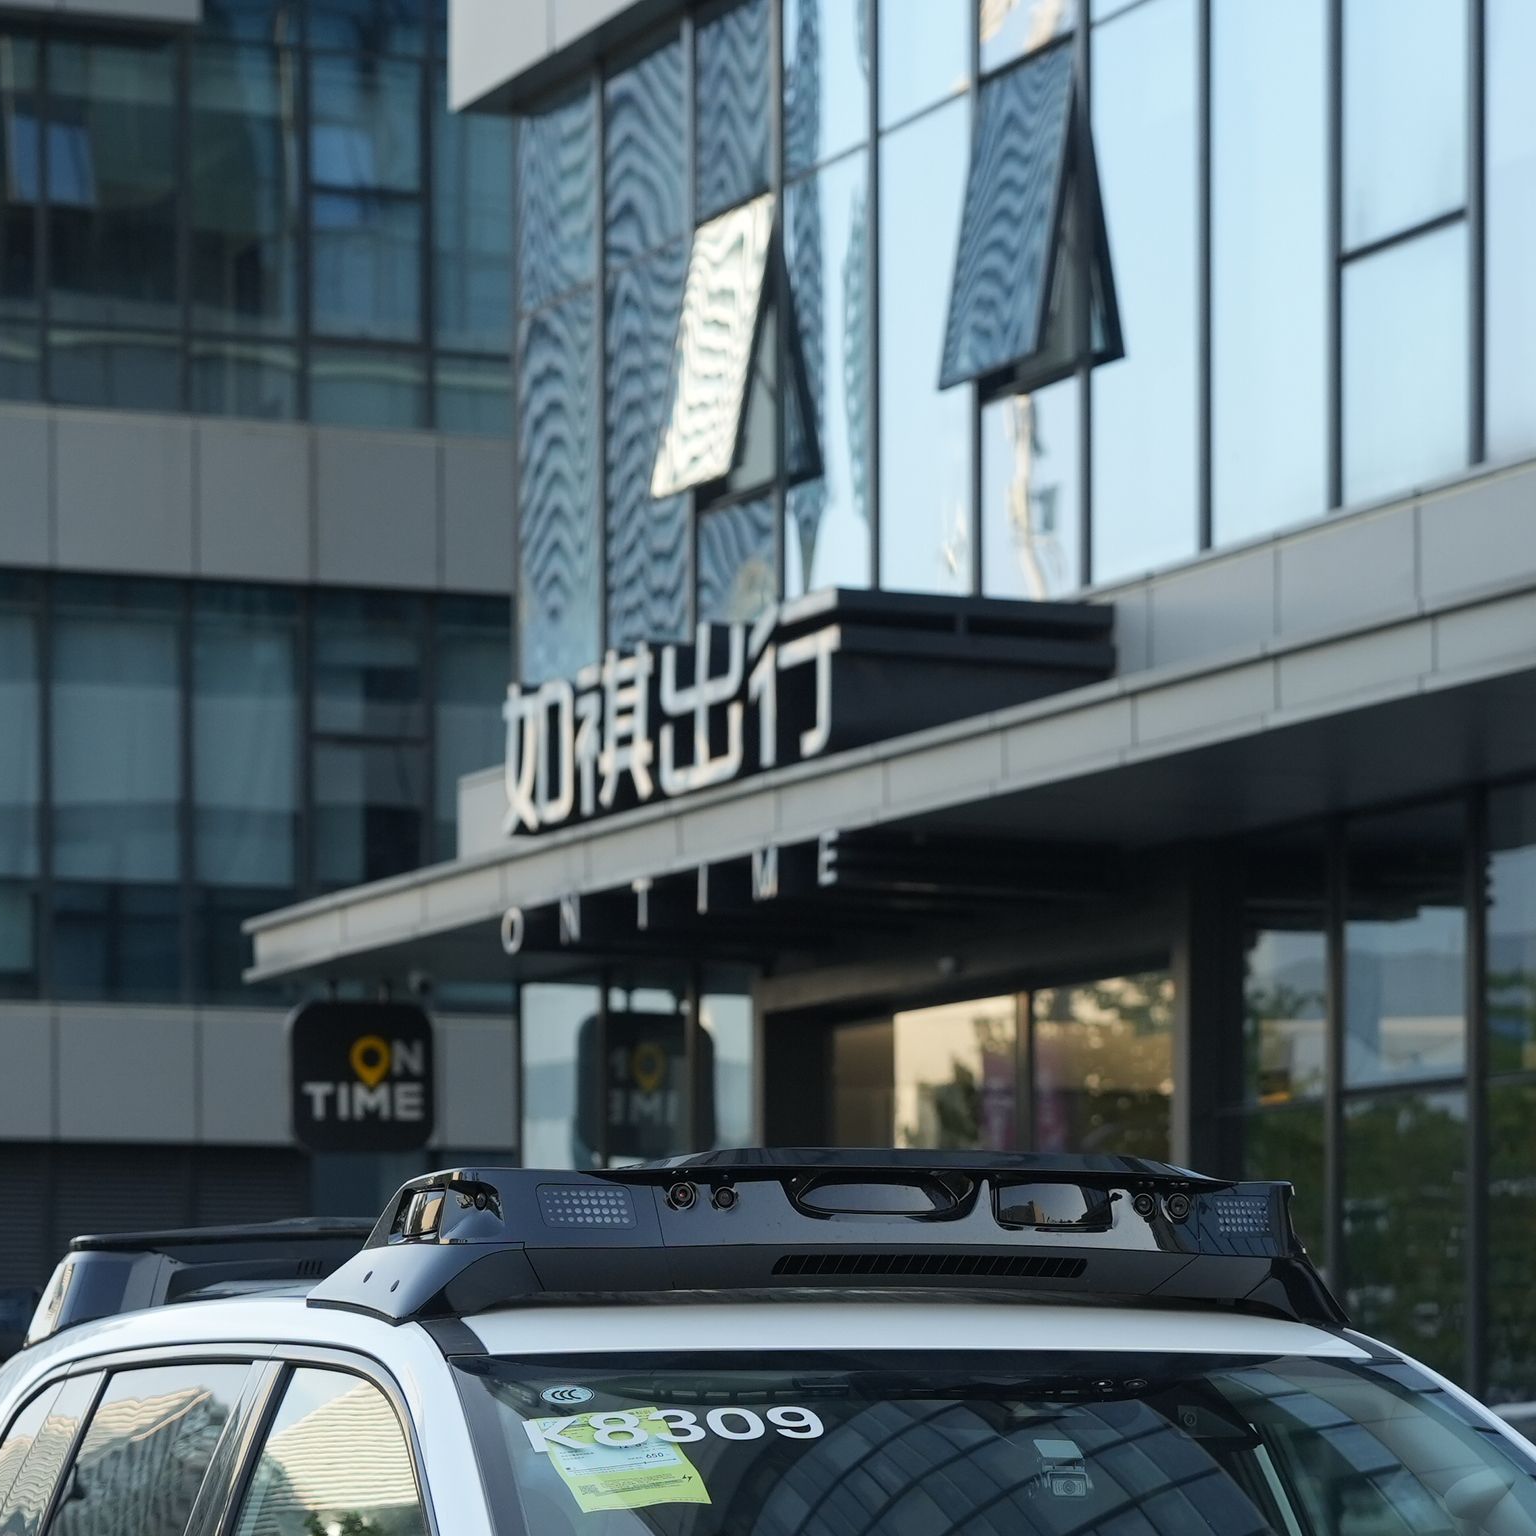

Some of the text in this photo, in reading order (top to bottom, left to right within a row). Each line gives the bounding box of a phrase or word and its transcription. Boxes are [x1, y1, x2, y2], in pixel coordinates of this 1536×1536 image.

[502, 588, 841, 834] 如祺出行
[350, 1036, 424, 1087] ON
[302, 1081, 425, 1122] TIME
[522, 1406, 824, 1453] K8309
